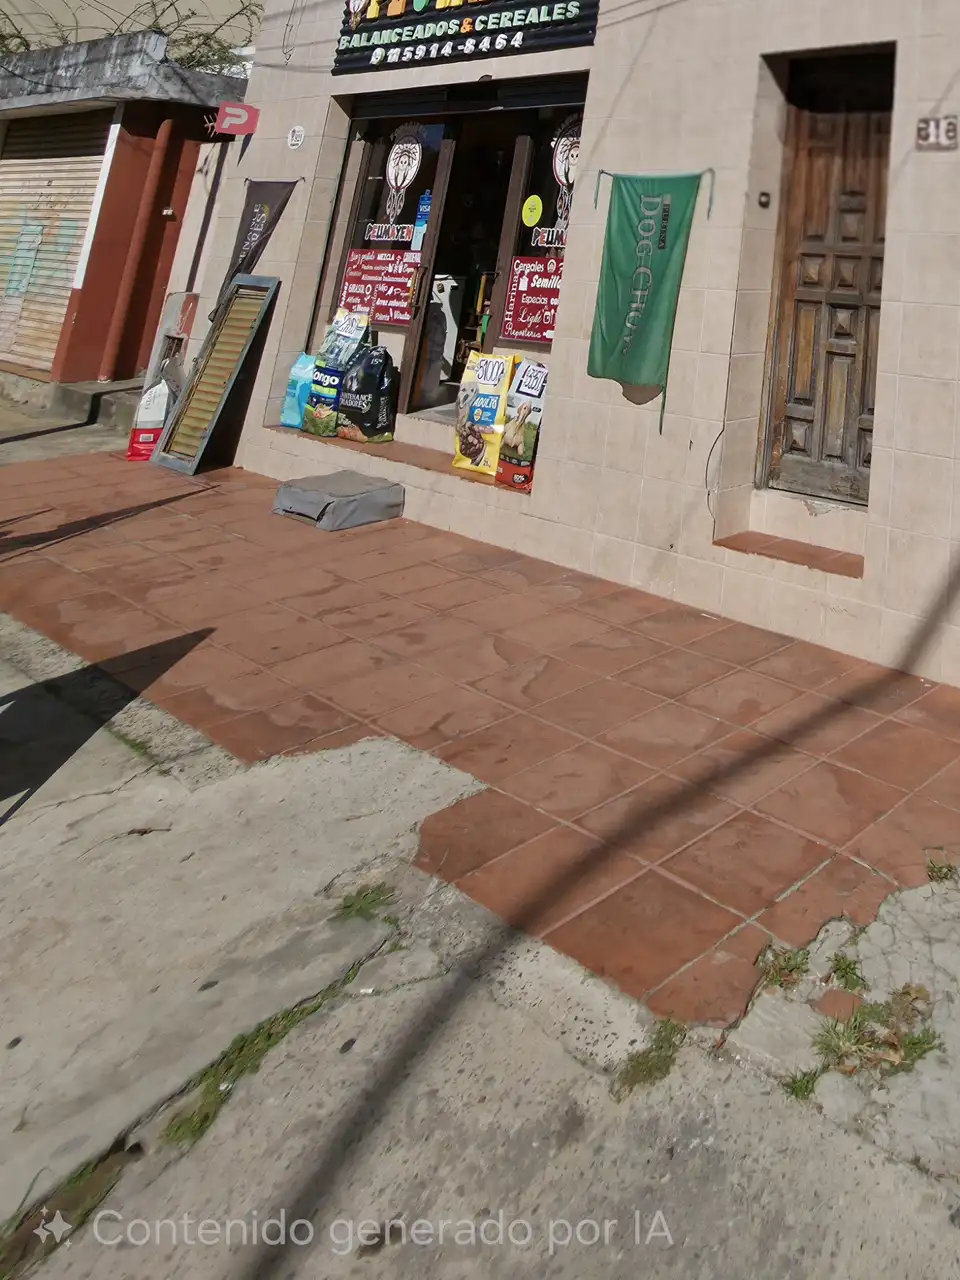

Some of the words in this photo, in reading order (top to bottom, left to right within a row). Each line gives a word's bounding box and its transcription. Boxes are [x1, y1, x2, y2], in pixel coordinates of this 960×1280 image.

[339, 19, 459, 50] BALANCEADOS
[474, 1, 580, 31] CEREALES
[364, 223, 414, 241] PEUMAYEN
[635, 195, 662, 256] DOG
[514, 260, 544, 274] Cereales
[313, 369, 339, 386] ongo
